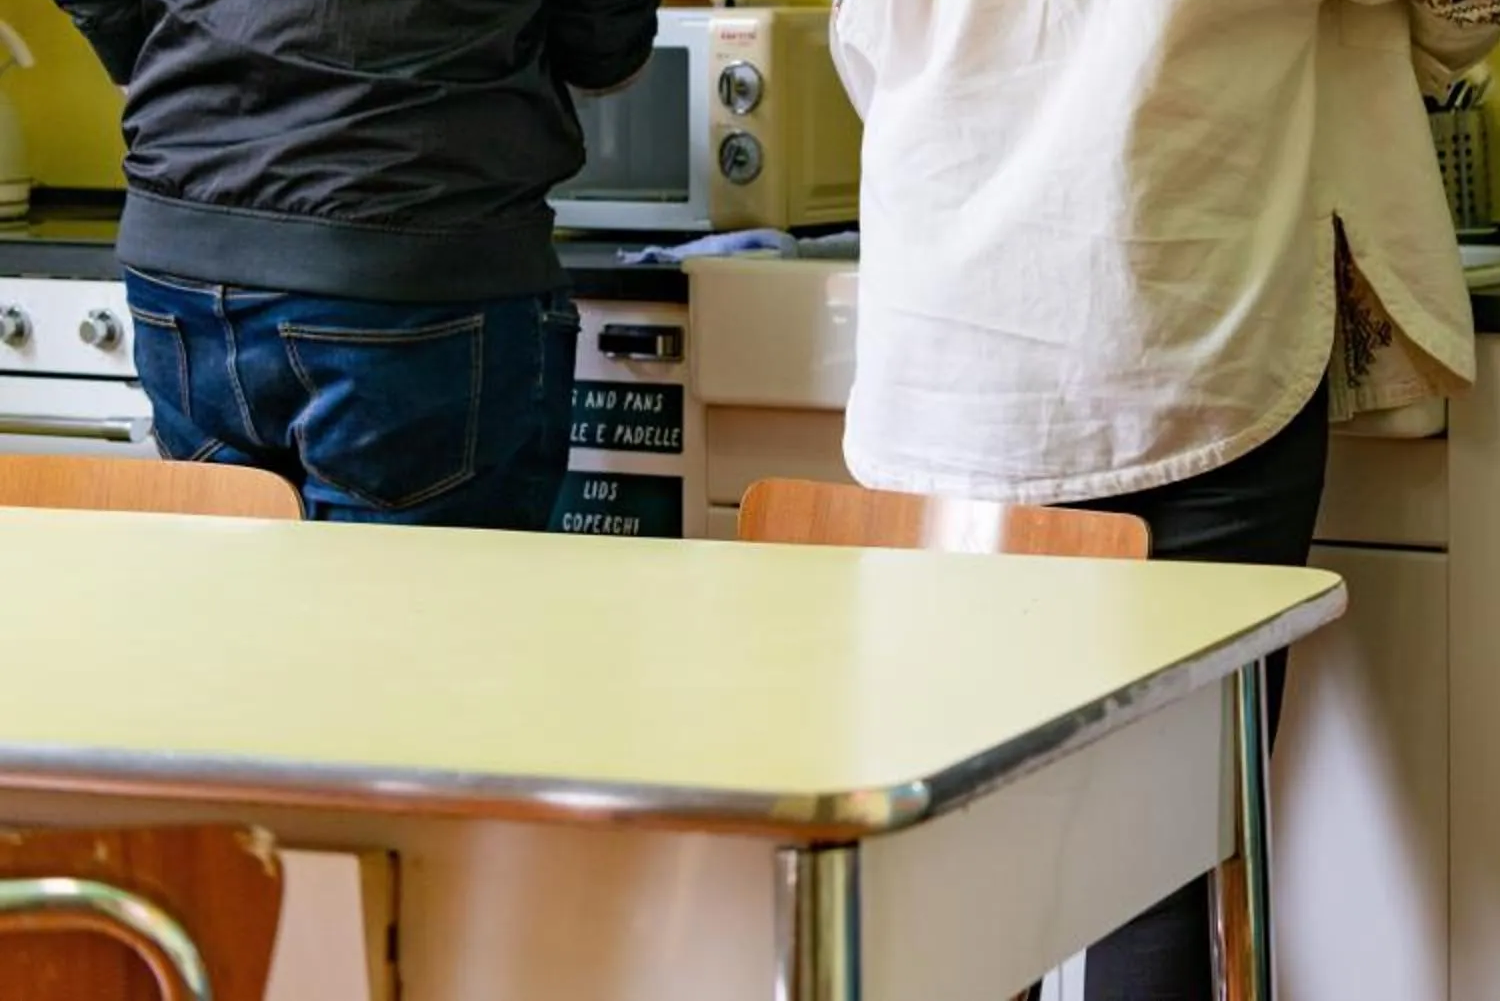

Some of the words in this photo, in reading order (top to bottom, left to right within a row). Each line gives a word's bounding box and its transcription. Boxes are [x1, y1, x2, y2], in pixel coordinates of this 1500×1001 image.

[585, 390, 618, 410] AND
[622, 391, 664, 414] PANS
[595, 423, 608, 444] E
[613, 424, 681, 447] PADELLE
[583, 479, 619, 502] LIDS
[562, 512, 640, 536] COPERCHI
